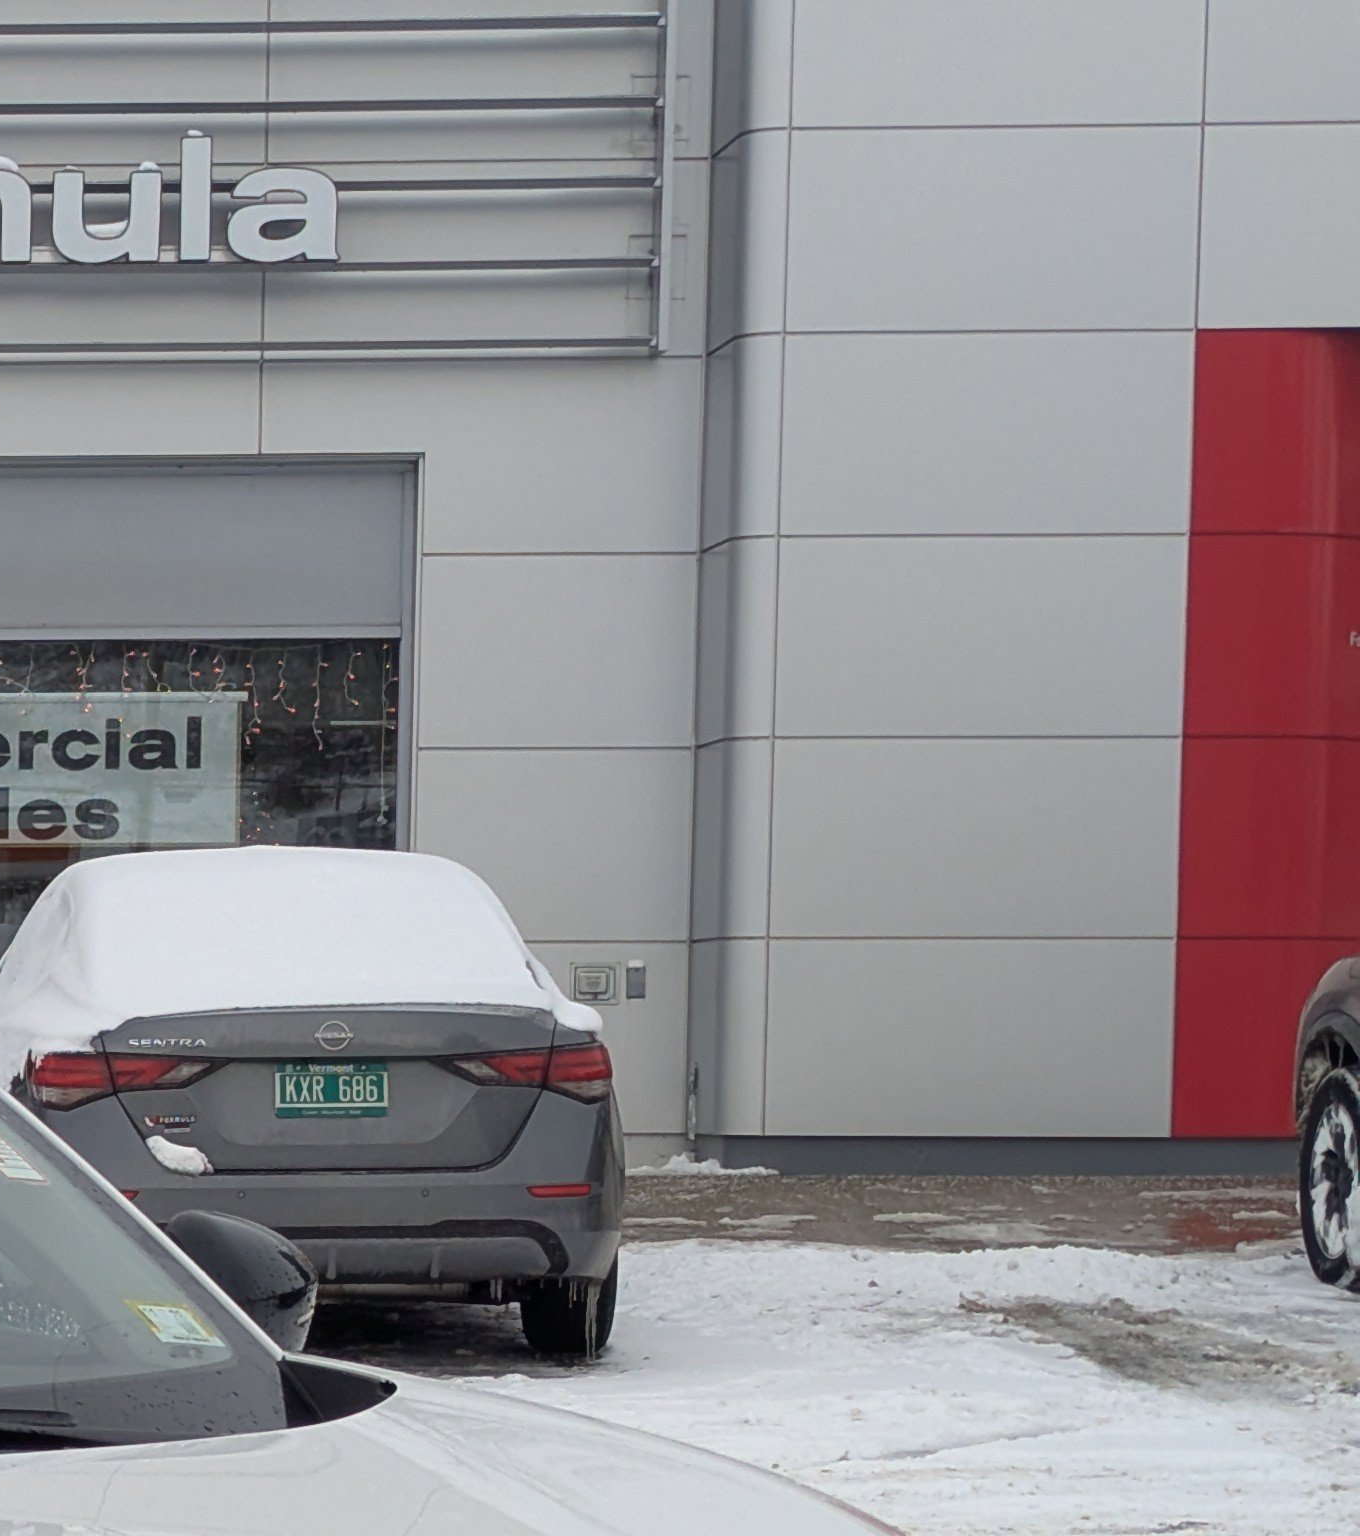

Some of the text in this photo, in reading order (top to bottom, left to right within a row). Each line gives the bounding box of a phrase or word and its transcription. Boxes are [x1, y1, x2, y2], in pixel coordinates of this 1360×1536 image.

[128, 1038, 208, 1049] SENTRA
[307, 1064, 355, 1074] Vermont
[285, 1075, 379, 1103] KXR 686
